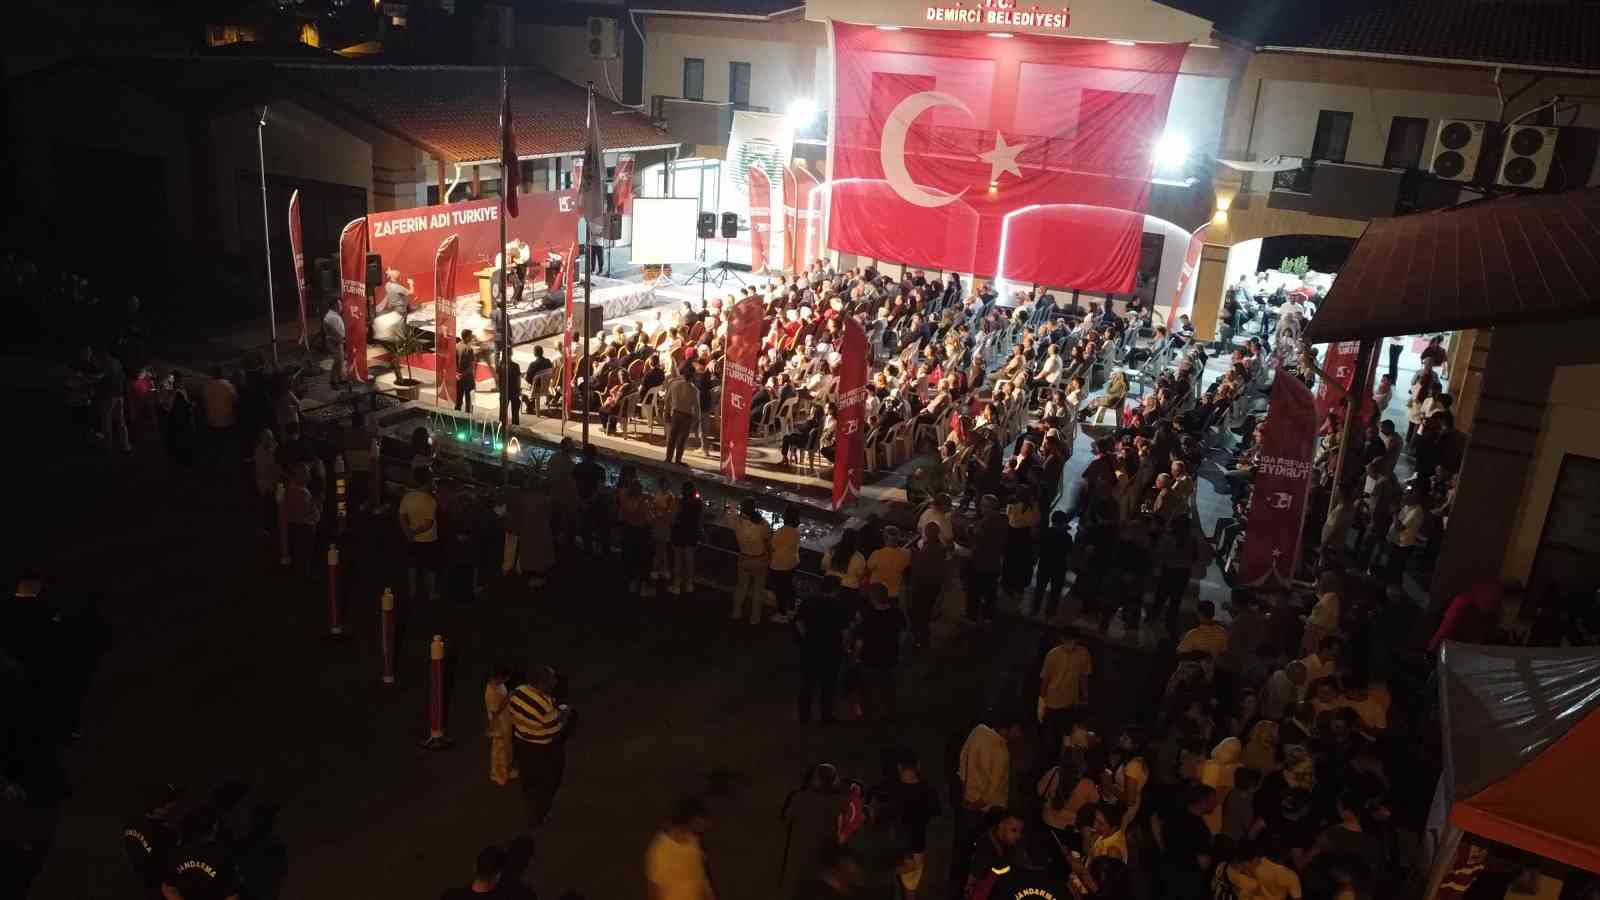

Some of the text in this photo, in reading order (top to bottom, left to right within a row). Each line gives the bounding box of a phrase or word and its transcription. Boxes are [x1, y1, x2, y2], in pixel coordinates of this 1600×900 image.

[927, 2, 1067, 27] DEMİRCİ BELEDİYESİ
[429, 211, 450, 229] ADI
